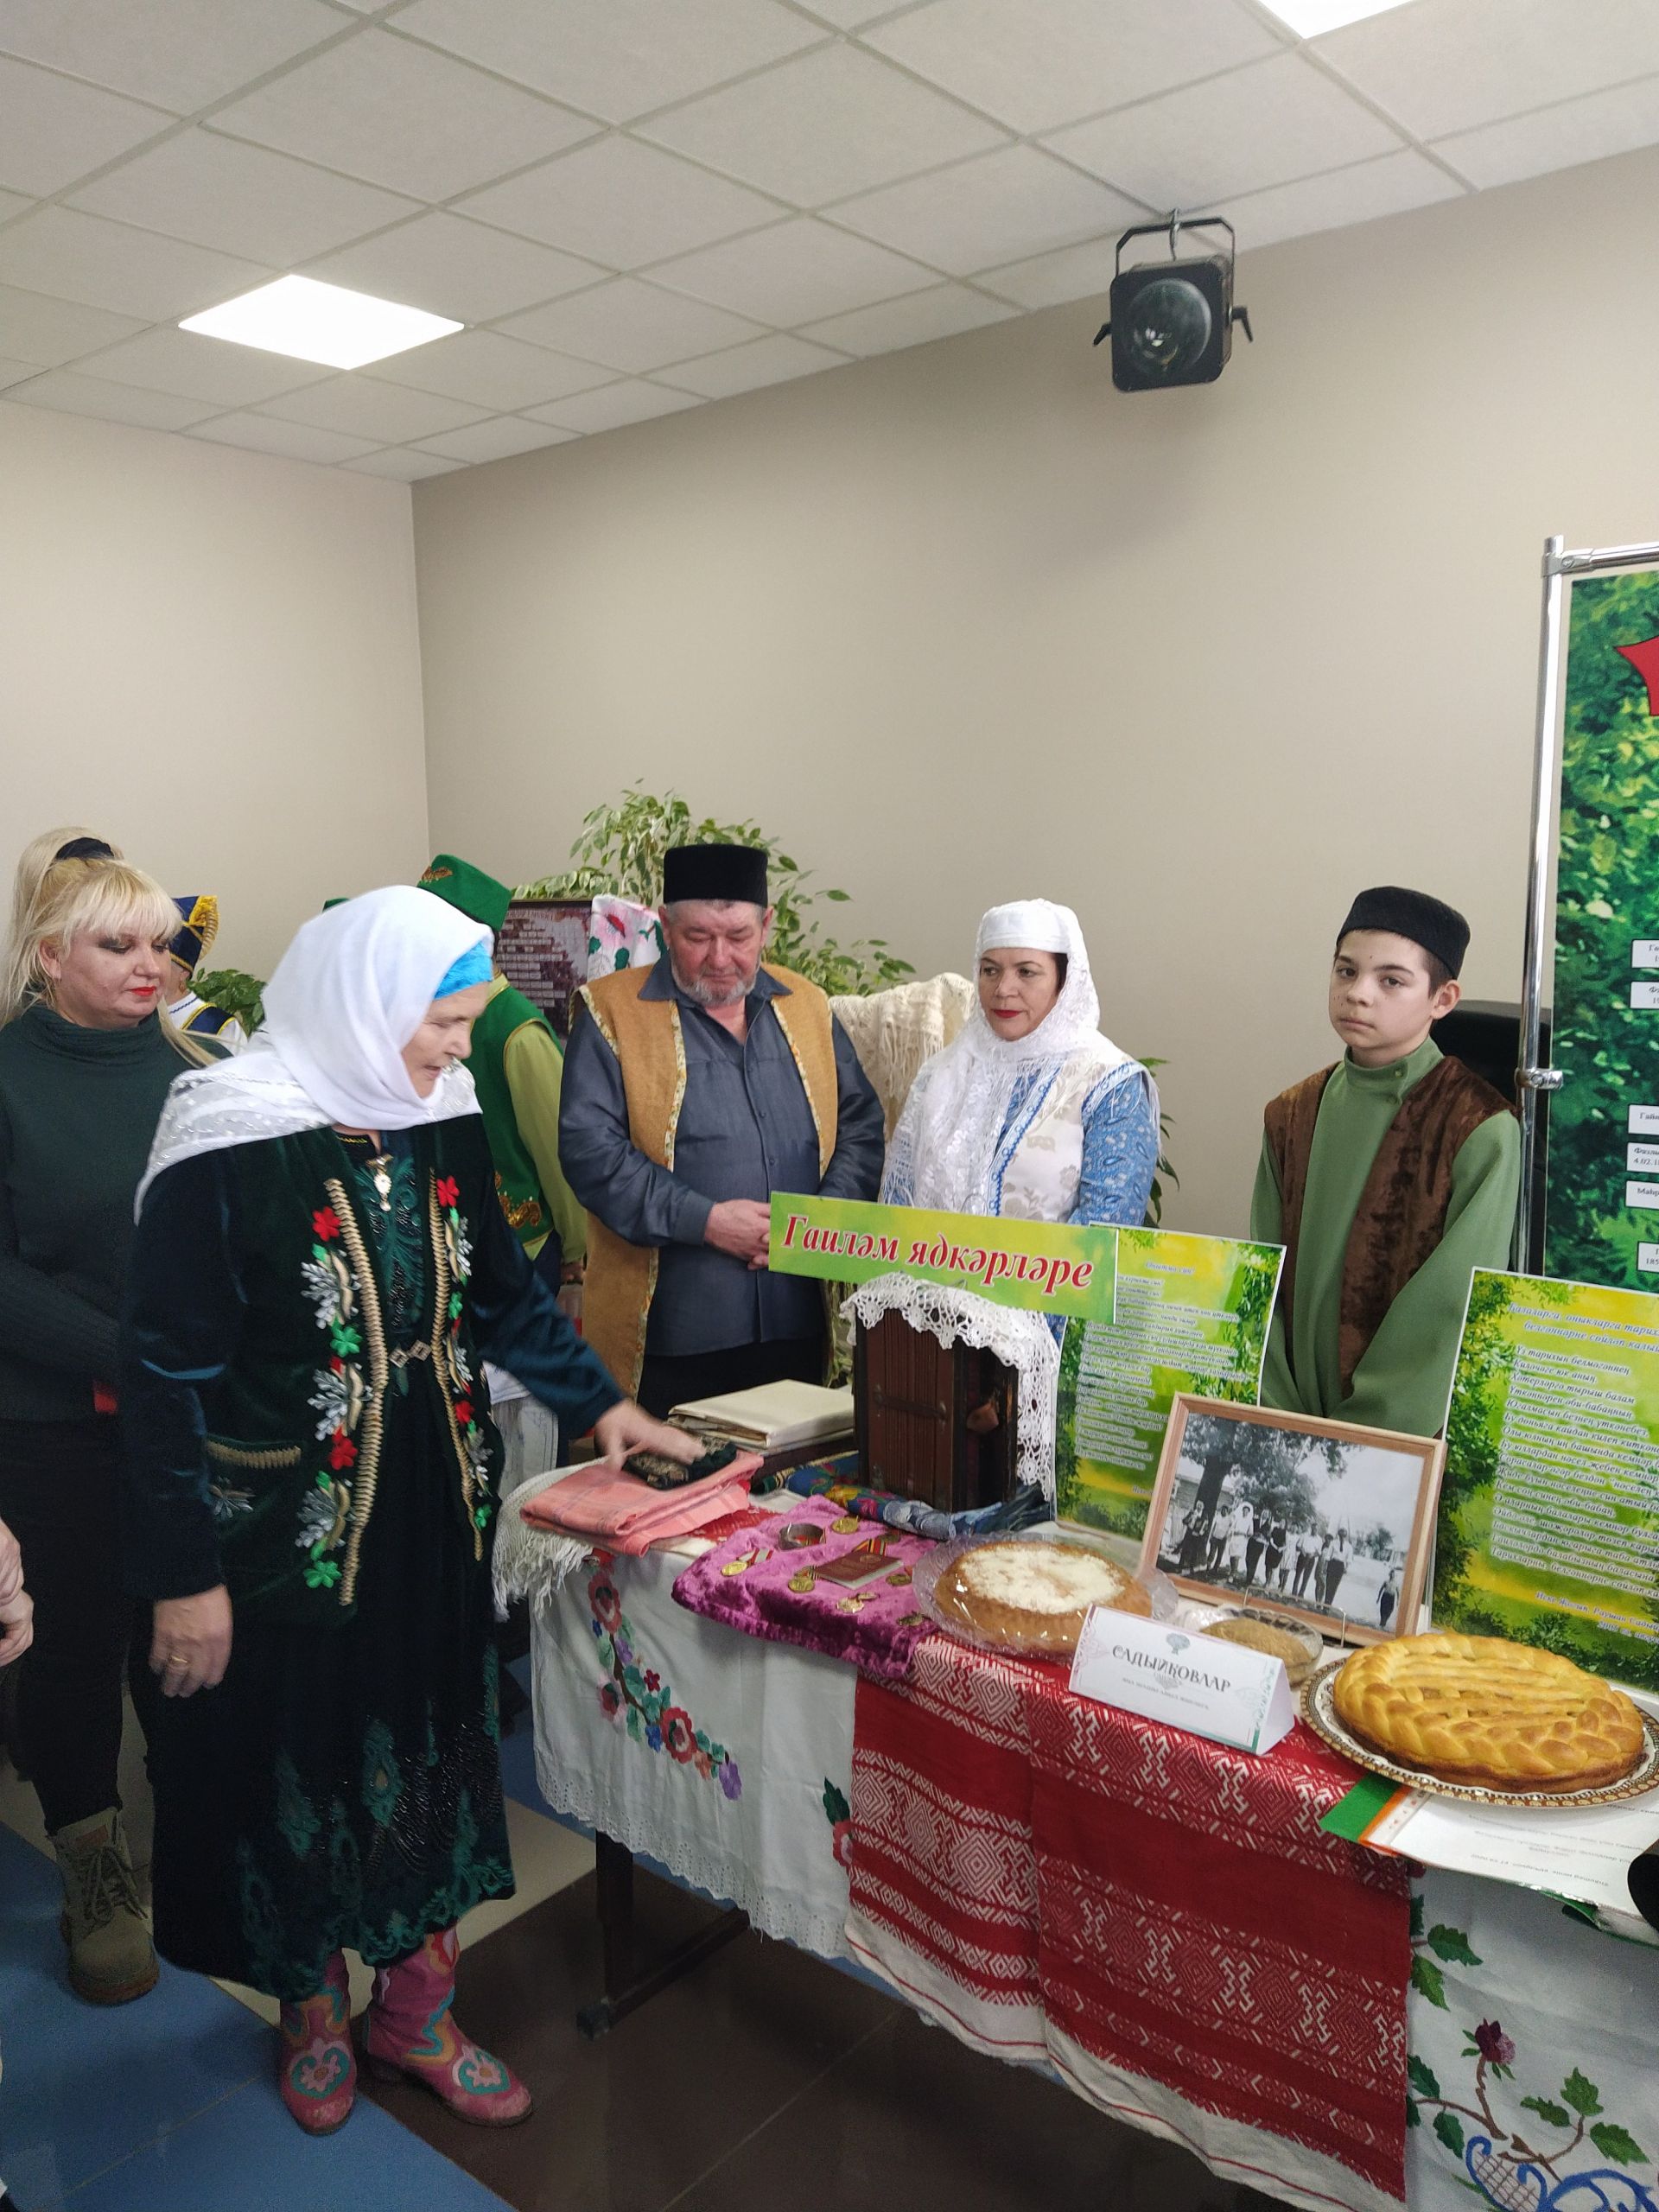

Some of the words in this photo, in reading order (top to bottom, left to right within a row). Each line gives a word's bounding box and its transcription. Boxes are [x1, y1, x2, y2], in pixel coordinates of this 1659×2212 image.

[781, 1215, 899, 1262] Гаиләм
[907, 1233, 1095, 1295] ядкәрләре
[1605, 1390, 1635, 1404] балам
